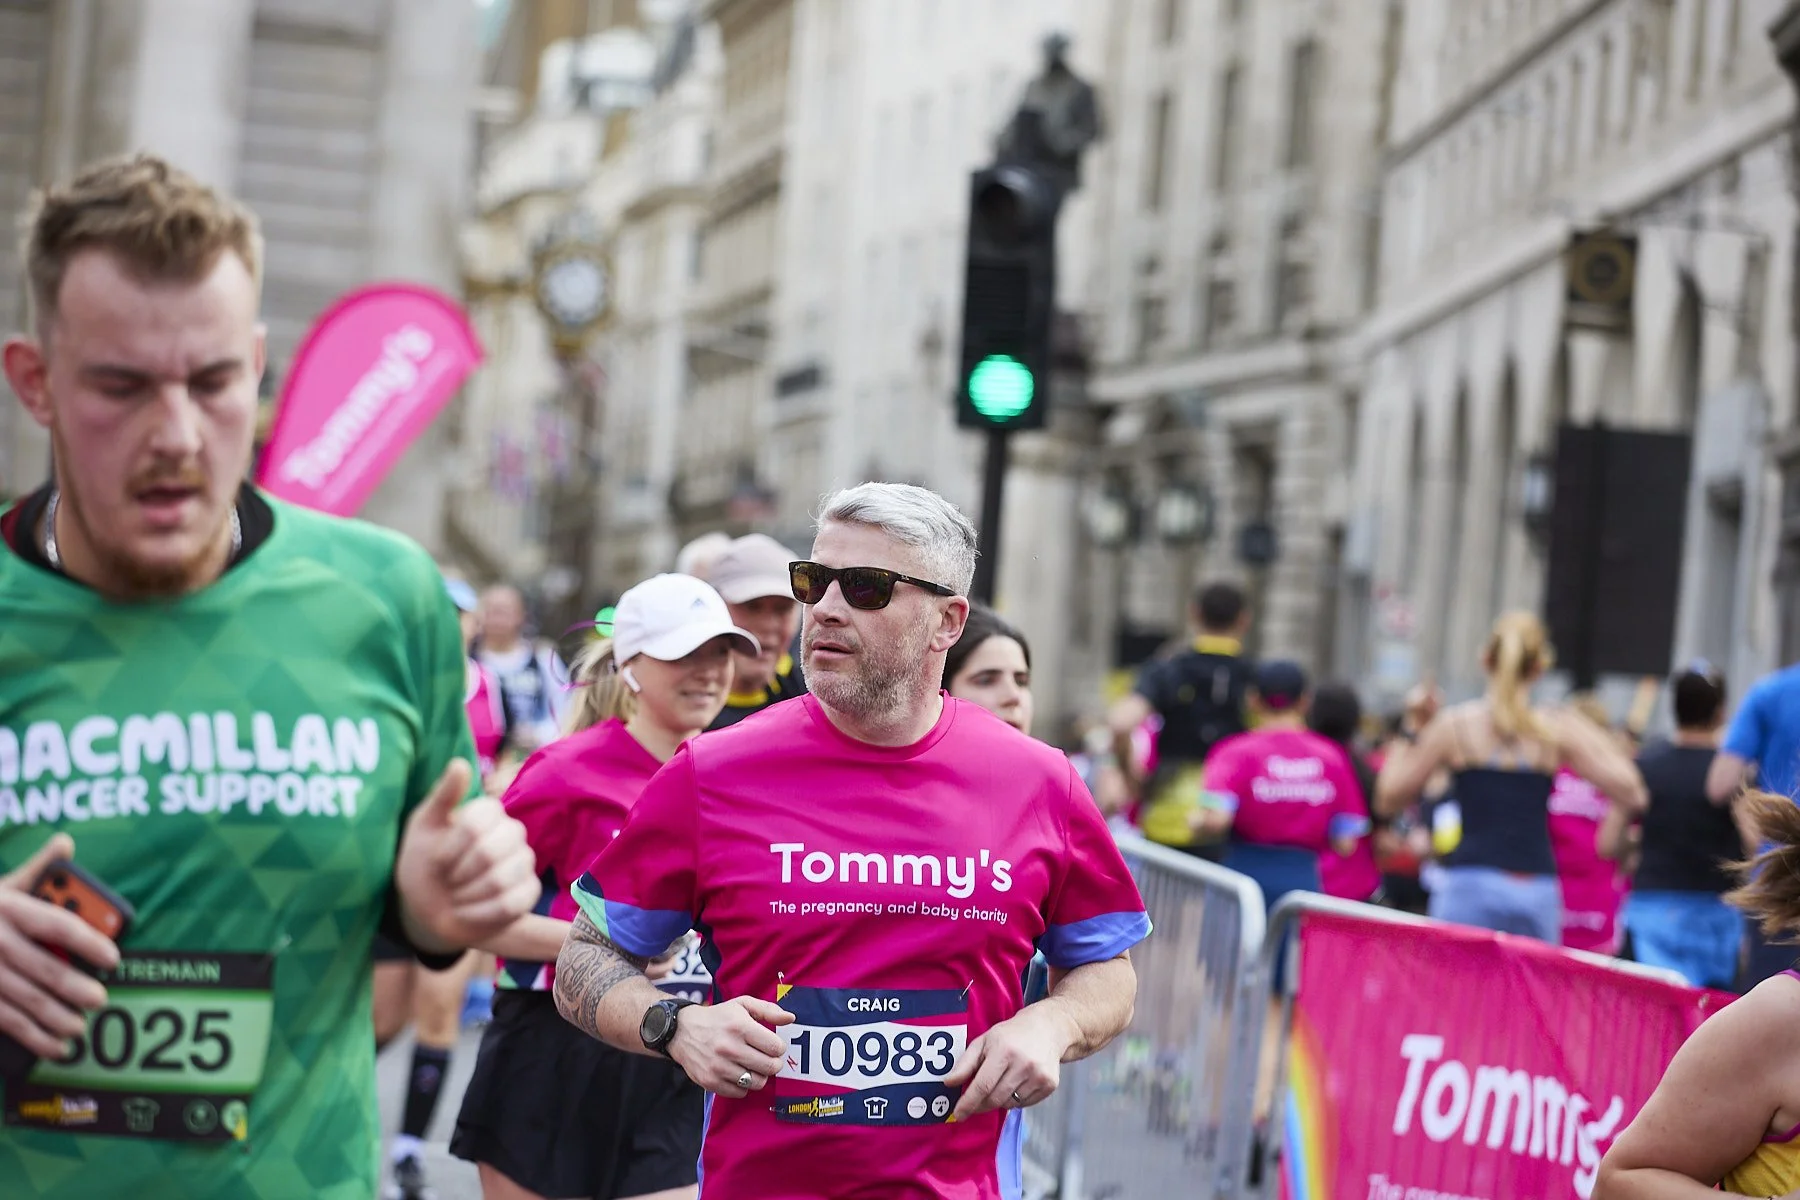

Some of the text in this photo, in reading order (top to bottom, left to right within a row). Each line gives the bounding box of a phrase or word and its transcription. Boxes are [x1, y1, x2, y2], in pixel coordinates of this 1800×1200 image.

[0, 712, 379, 784] ACMILLAN
[160, 773, 362, 816] SUPPORT
[770, 843, 1012, 898] Tommy's
[769, 901, 1008, 924] The pregnancy and baby charity
[118, 960, 220, 982] TREMAIN
[847, 998, 900, 1012] CRAIG
[790, 1031, 955, 1076] 10983
[788, 1102, 812, 1114] LONDON
